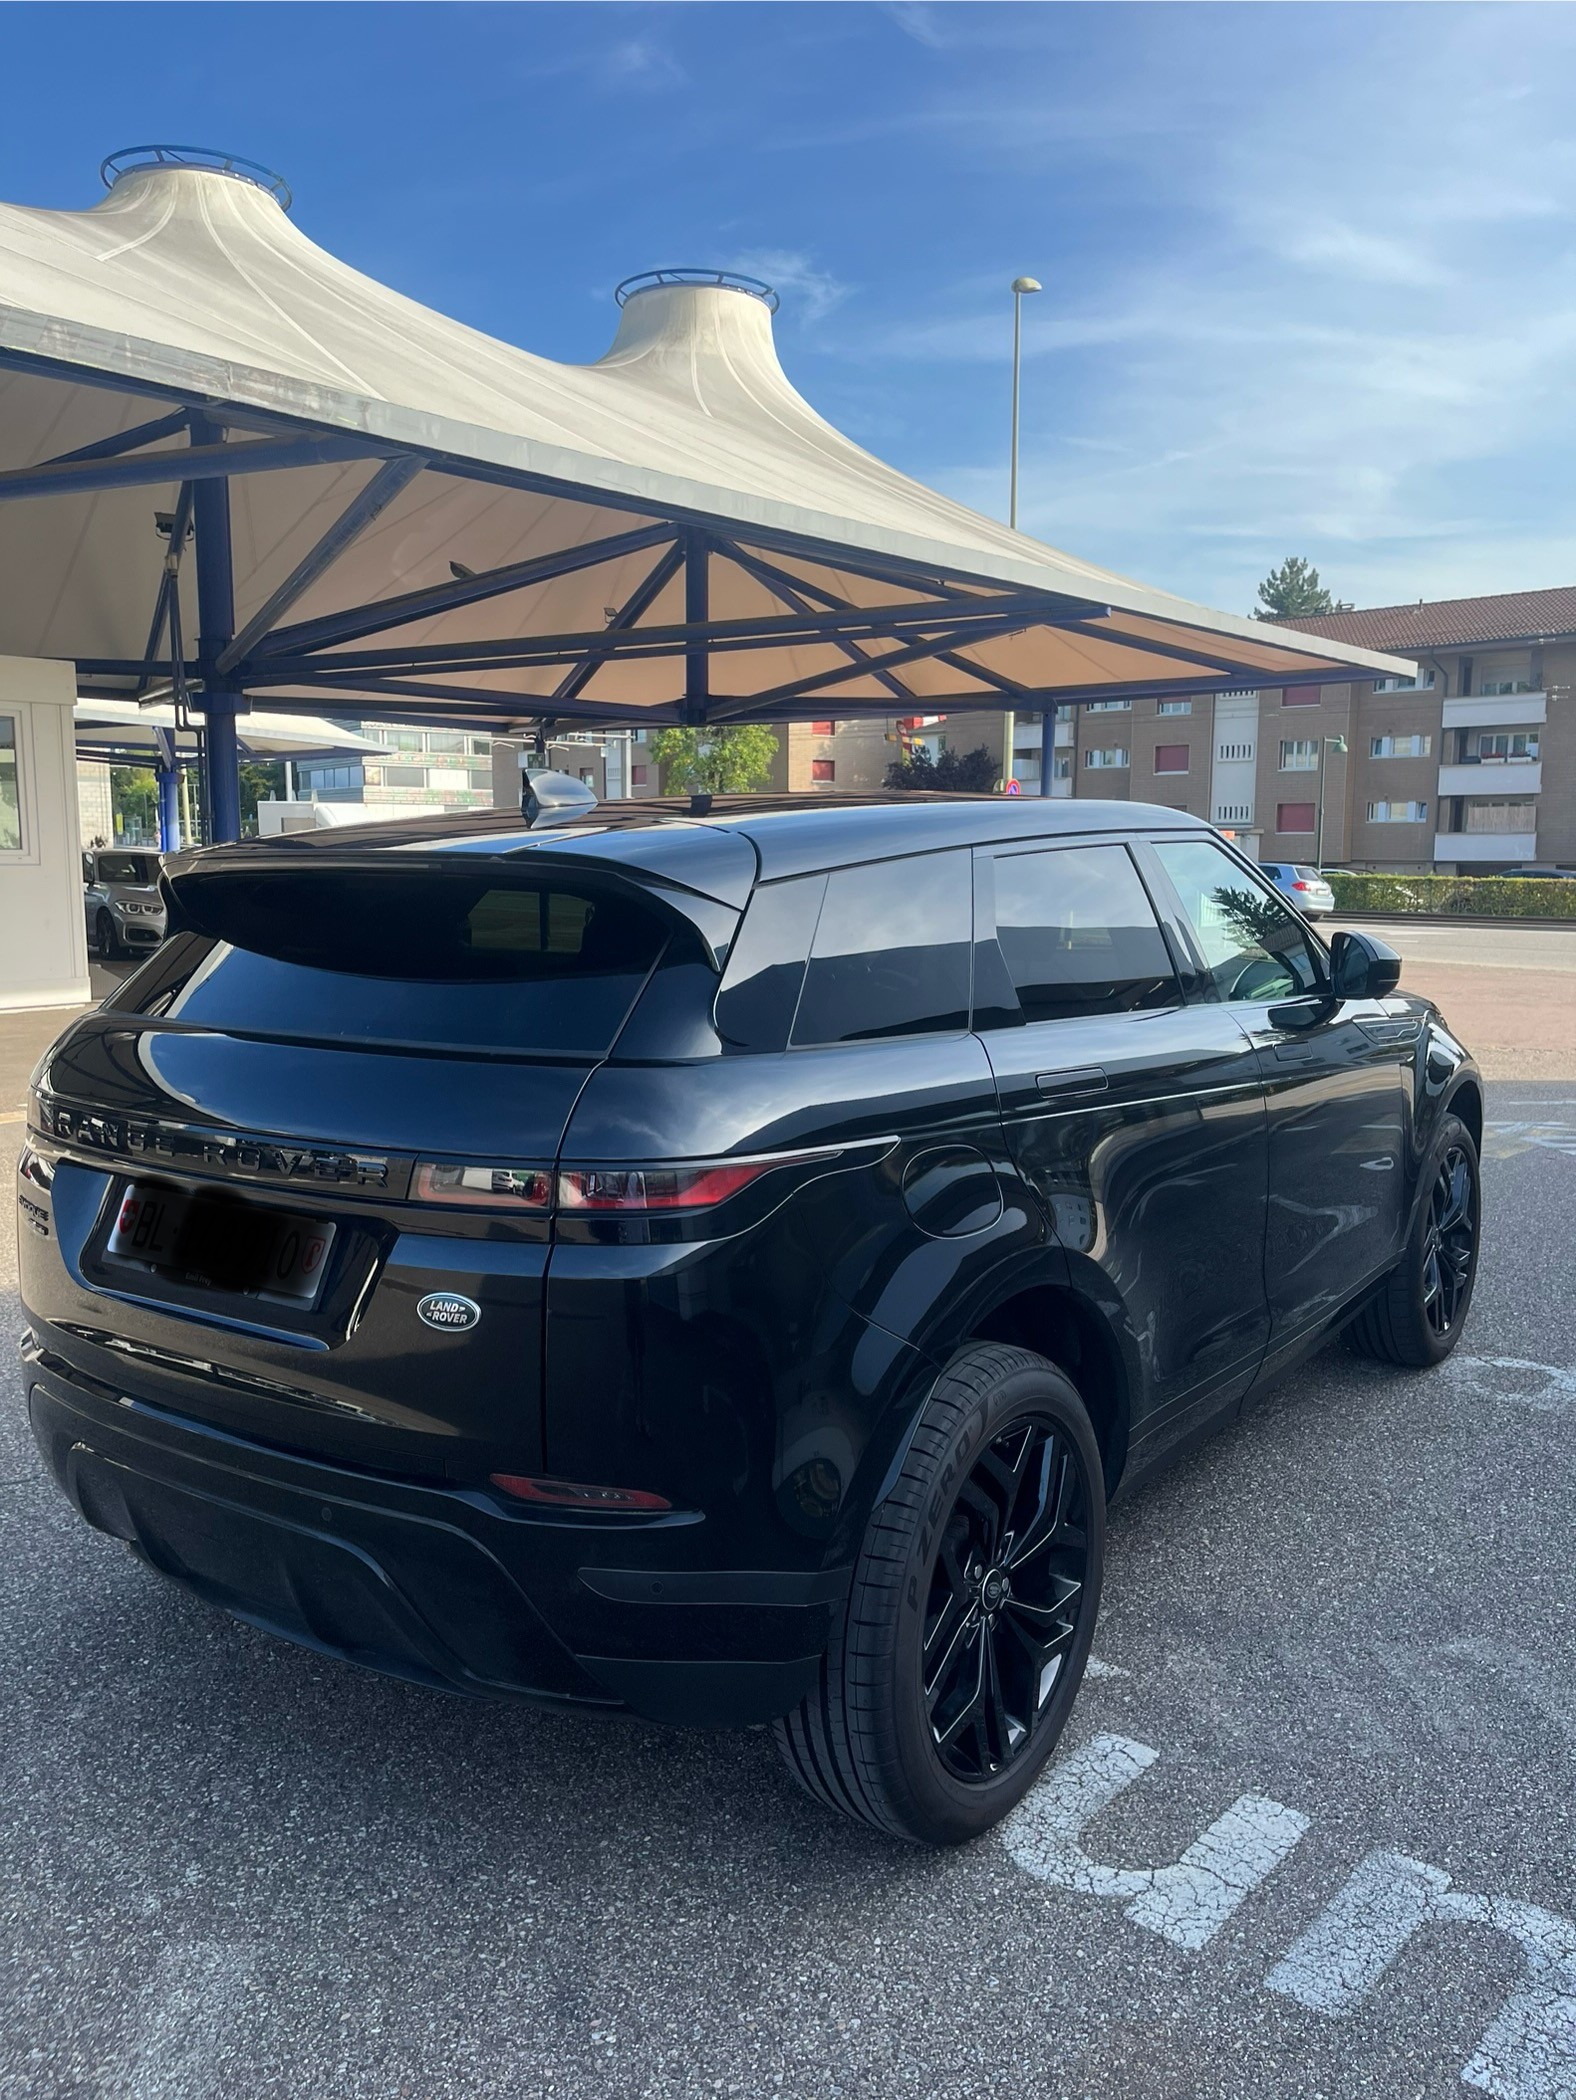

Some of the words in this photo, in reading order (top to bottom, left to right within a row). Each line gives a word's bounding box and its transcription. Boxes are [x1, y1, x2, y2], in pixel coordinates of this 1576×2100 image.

[55, 1112, 177, 1157] RANGE
[202, 1141, 389, 1187] ROVER
[131, 1201, 164, 1251] BL
[430, 1300, 459, 1313] LAND
[432, 1311, 468, 1324] ROVER
[916, 1429, 971, 1567] ZERO
